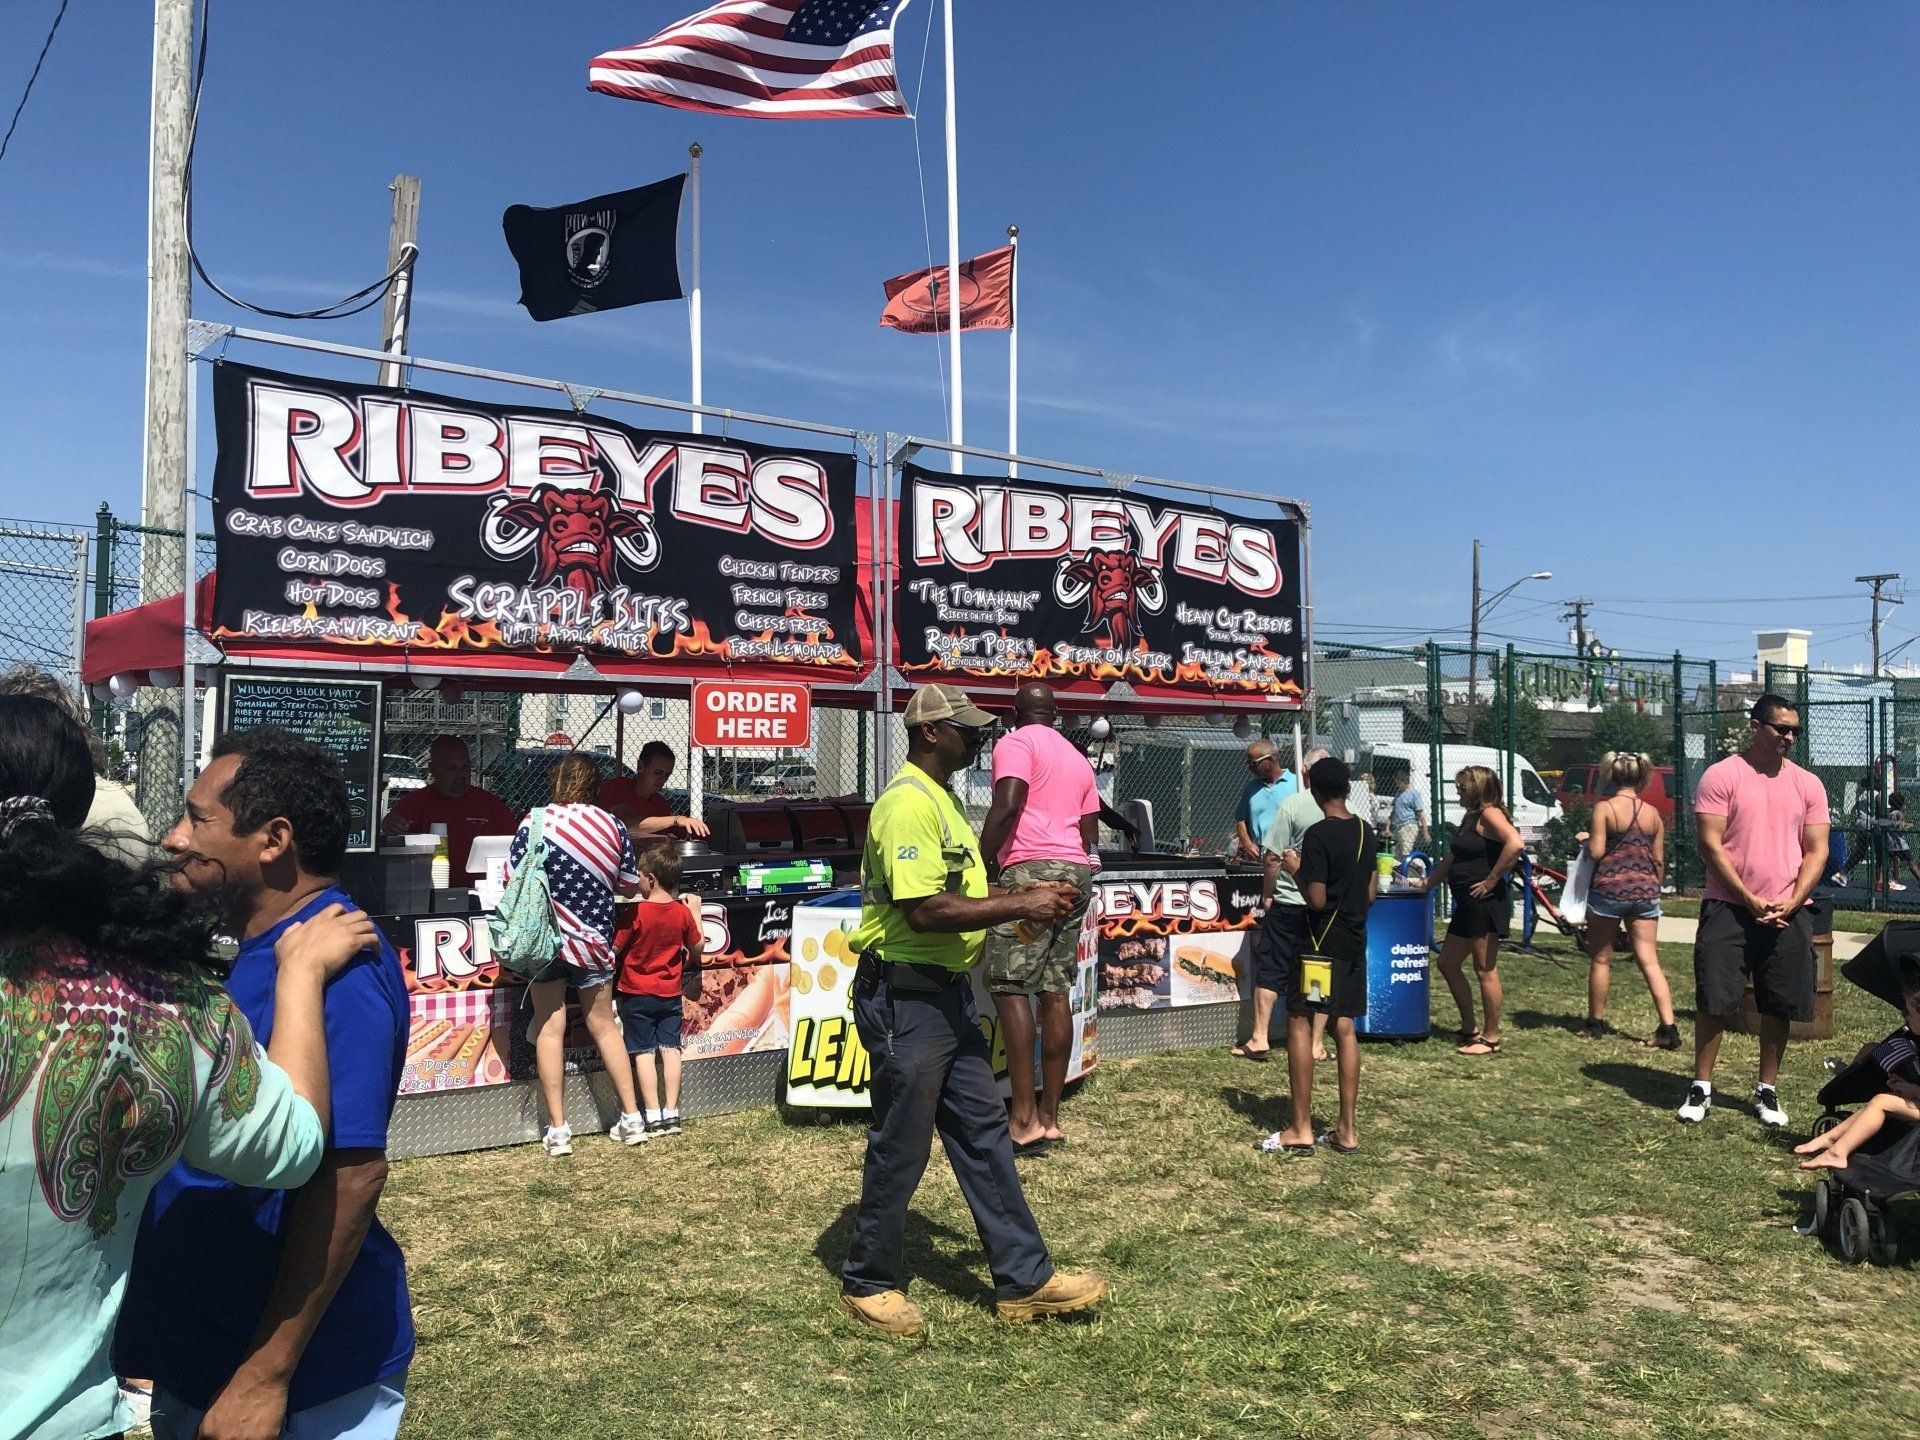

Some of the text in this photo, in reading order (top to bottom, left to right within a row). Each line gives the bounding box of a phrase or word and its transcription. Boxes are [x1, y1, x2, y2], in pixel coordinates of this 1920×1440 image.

[247, 377, 834, 550] RIBEYES
[229, 511, 433, 548] CRAB CAKE SANDWICH
[913, 477, 1283, 597] RIBEYES
[280, 550, 384, 575] CORN DOGS
[720, 557, 839, 582] CHICKEN TENDERS
[288, 584, 379, 606] HOT DOGS
[450, 578, 690, 633] SCRAPPLE BITES
[732, 585, 828, 608] FRENCH FRIES
[245, 612, 340, 635] KIELBASA
[737, 612, 828, 633] CHEESE FRIES
[938, 604, 969, 620] RIBEYE
[995, 608, 1018, 623] BONE
[1177, 603, 1293, 632] HEAVY CUT RIBEYE
[502, 625, 650, 652] WITH APPLE BUTTER
[925, 628, 980, 652] ROAST
[982, 632, 1026, 655] PORK
[1207, 627, 1230, 641] STEAK
[728, 638, 842, 657] FRESH LEMONADE
[1054, 643, 1103, 664] STEAK
[1105, 649, 1123, 663] ON
[1132, 648, 1173, 670] STICK
[1183, 643, 1293, 671] ITALIAN SAUSAGE
[237, 684, 361, 699] WILDWOOD BLOCK PARTY
[706, 691, 797, 713] ORDER
[234, 699, 278, 708] TOMAHAWK
[281, 701, 305, 709] STEAK
[235, 708, 262, 717] RIBEYE
[266, 709, 295, 718] CHEESE
[298, 711, 325, 720] STEAK
[234, 716, 263, 725] RIBEYE
[265, 717, 291, 725] STEAK
[313, 719, 337, 728] STICK
[716, 718, 788, 739] HERE
[897, 845, 919, 860] 28
[1231, 889, 1261, 908] HEAVY
[763, 900, 789, 923] ICE
[758, 923, 793, 942] LEMONA
[713, 1027, 761, 1042] SANDWICH
[423, 1058, 457, 1074] DOGS
[400, 1073, 468, 1091] CORN DOGS
